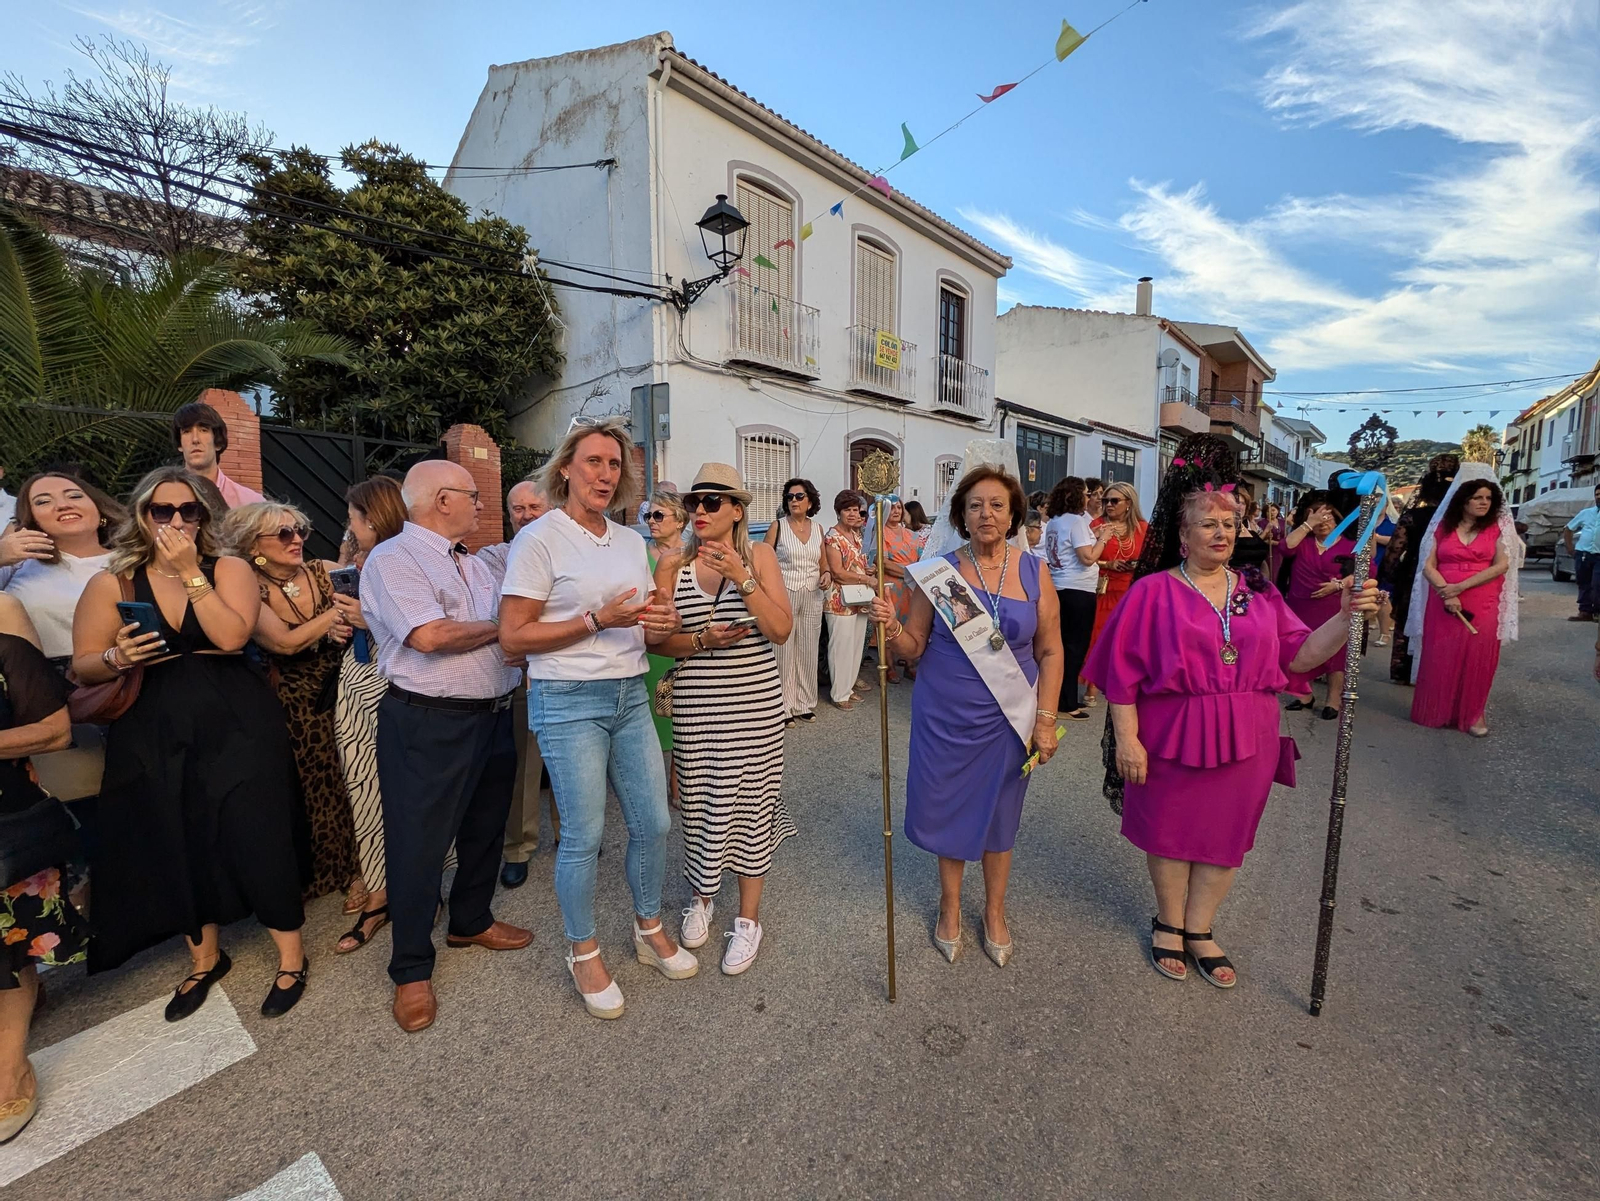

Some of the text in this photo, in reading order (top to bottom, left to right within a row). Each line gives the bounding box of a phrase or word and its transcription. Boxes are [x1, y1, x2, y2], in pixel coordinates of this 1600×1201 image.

[880, 344, 898, 357] SE VENDE
[920, 565, 950, 585] SAGRADA FAMILIA
